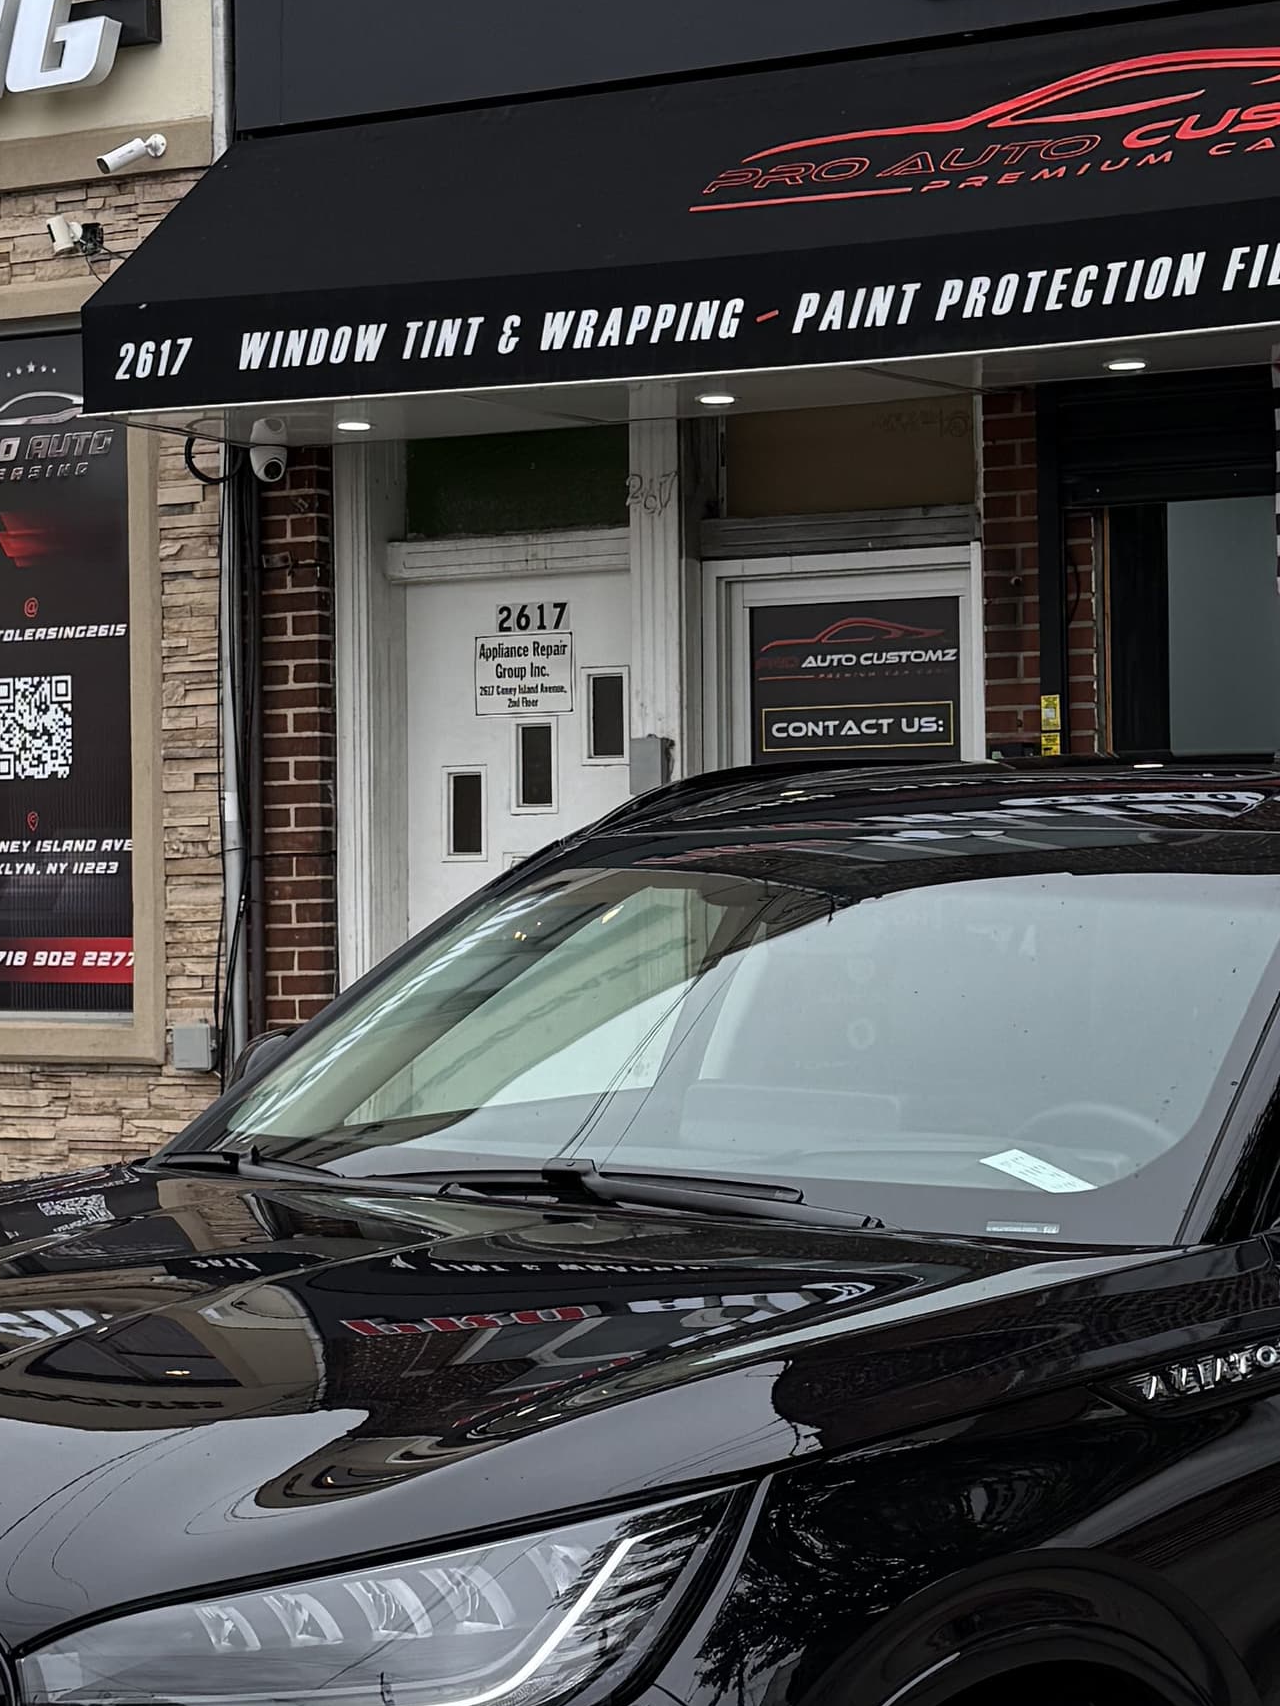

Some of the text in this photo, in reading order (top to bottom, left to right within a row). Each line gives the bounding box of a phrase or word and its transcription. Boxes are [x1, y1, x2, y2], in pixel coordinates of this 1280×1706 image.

[703, 157, 875, 194] PRO
[876, 133, 1101, 178] AUTO
[920, 151, 1174, 193] PREMIUM
[238, 323, 387, 371] WINDOW
[402, 316, 480, 360] TINT
[496, 315, 520, 354] &
[539, 297, 745, 351] WRAPPING
[792, 282, 921, 334] PAINT
[935, 251, 1206, 321] PROTECTION
[115, 337, 193, 380] 2617
[25, 429, 114, 460] AUTO
[498, 602, 568, 632] 2617
[479, 640, 568, 661] Appliance Repair
[801, 653, 857, 669] AUTO
[859, 648, 958, 666] CUSTOMZ
[495, 662, 550, 681] Group Inc.
[772, 716, 944, 738] CONTACT US:
[35, 840, 96, 852] ISLAND
[100, 839, 133, 851] AVE
[46, 863, 68, 874] NY
[72, 861, 119, 874] 11223
[33, 951, 76, 967] 902
[82, 951, 135, 967] 2277
